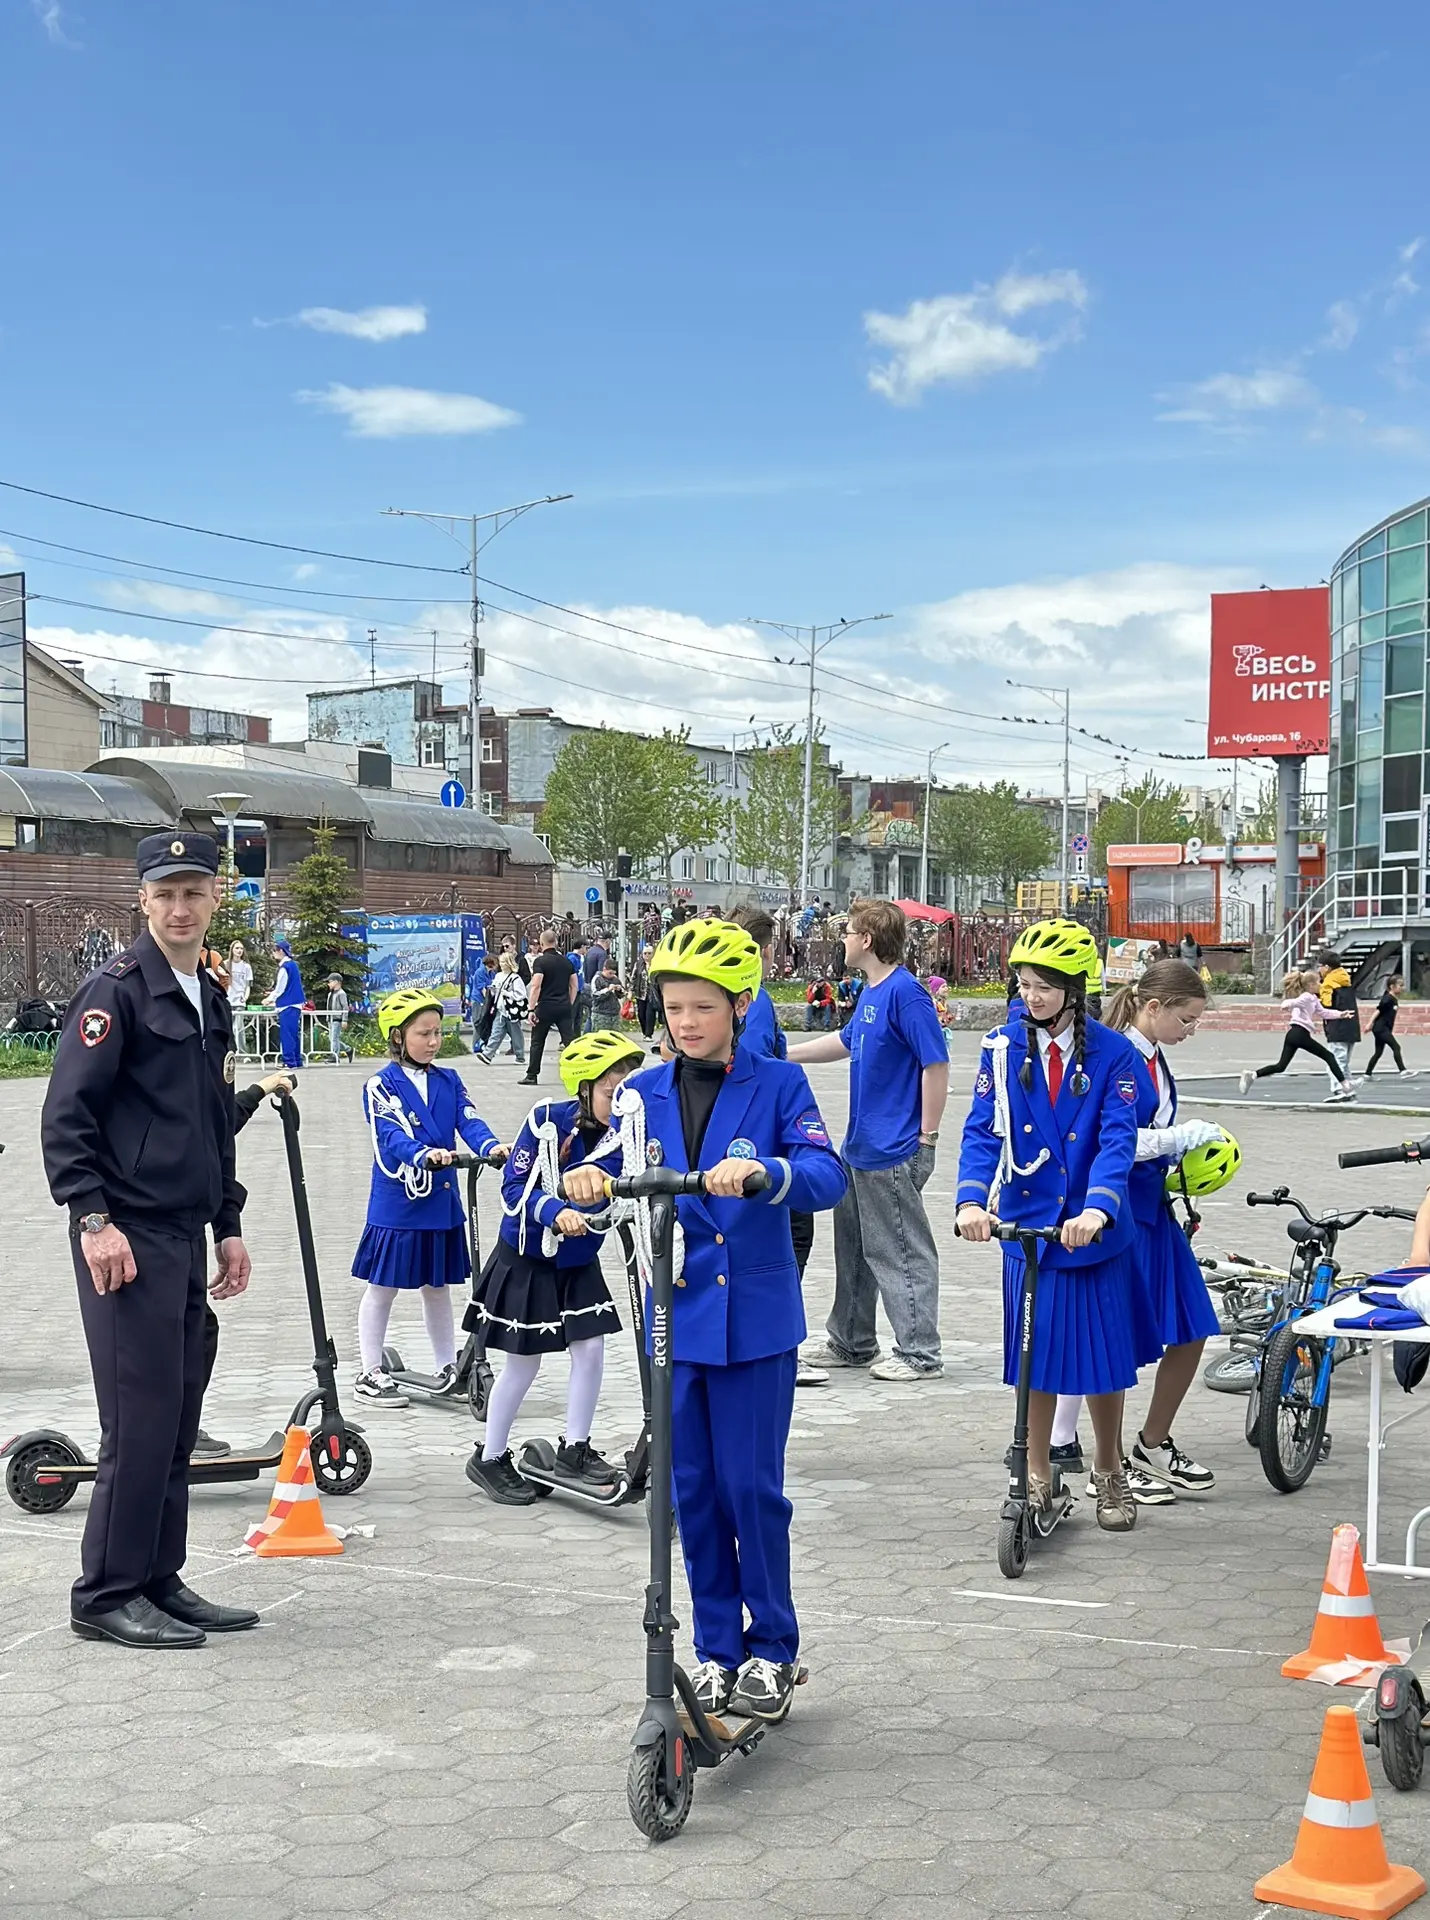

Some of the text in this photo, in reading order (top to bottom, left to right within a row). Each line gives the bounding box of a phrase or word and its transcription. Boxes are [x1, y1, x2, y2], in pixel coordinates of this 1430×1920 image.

[1252, 655, 1316, 676] ВЕСЬ
[1213, 731, 1301, 746] ул. Чубарова, 16
[651, 1304, 667, 1367] aceline
